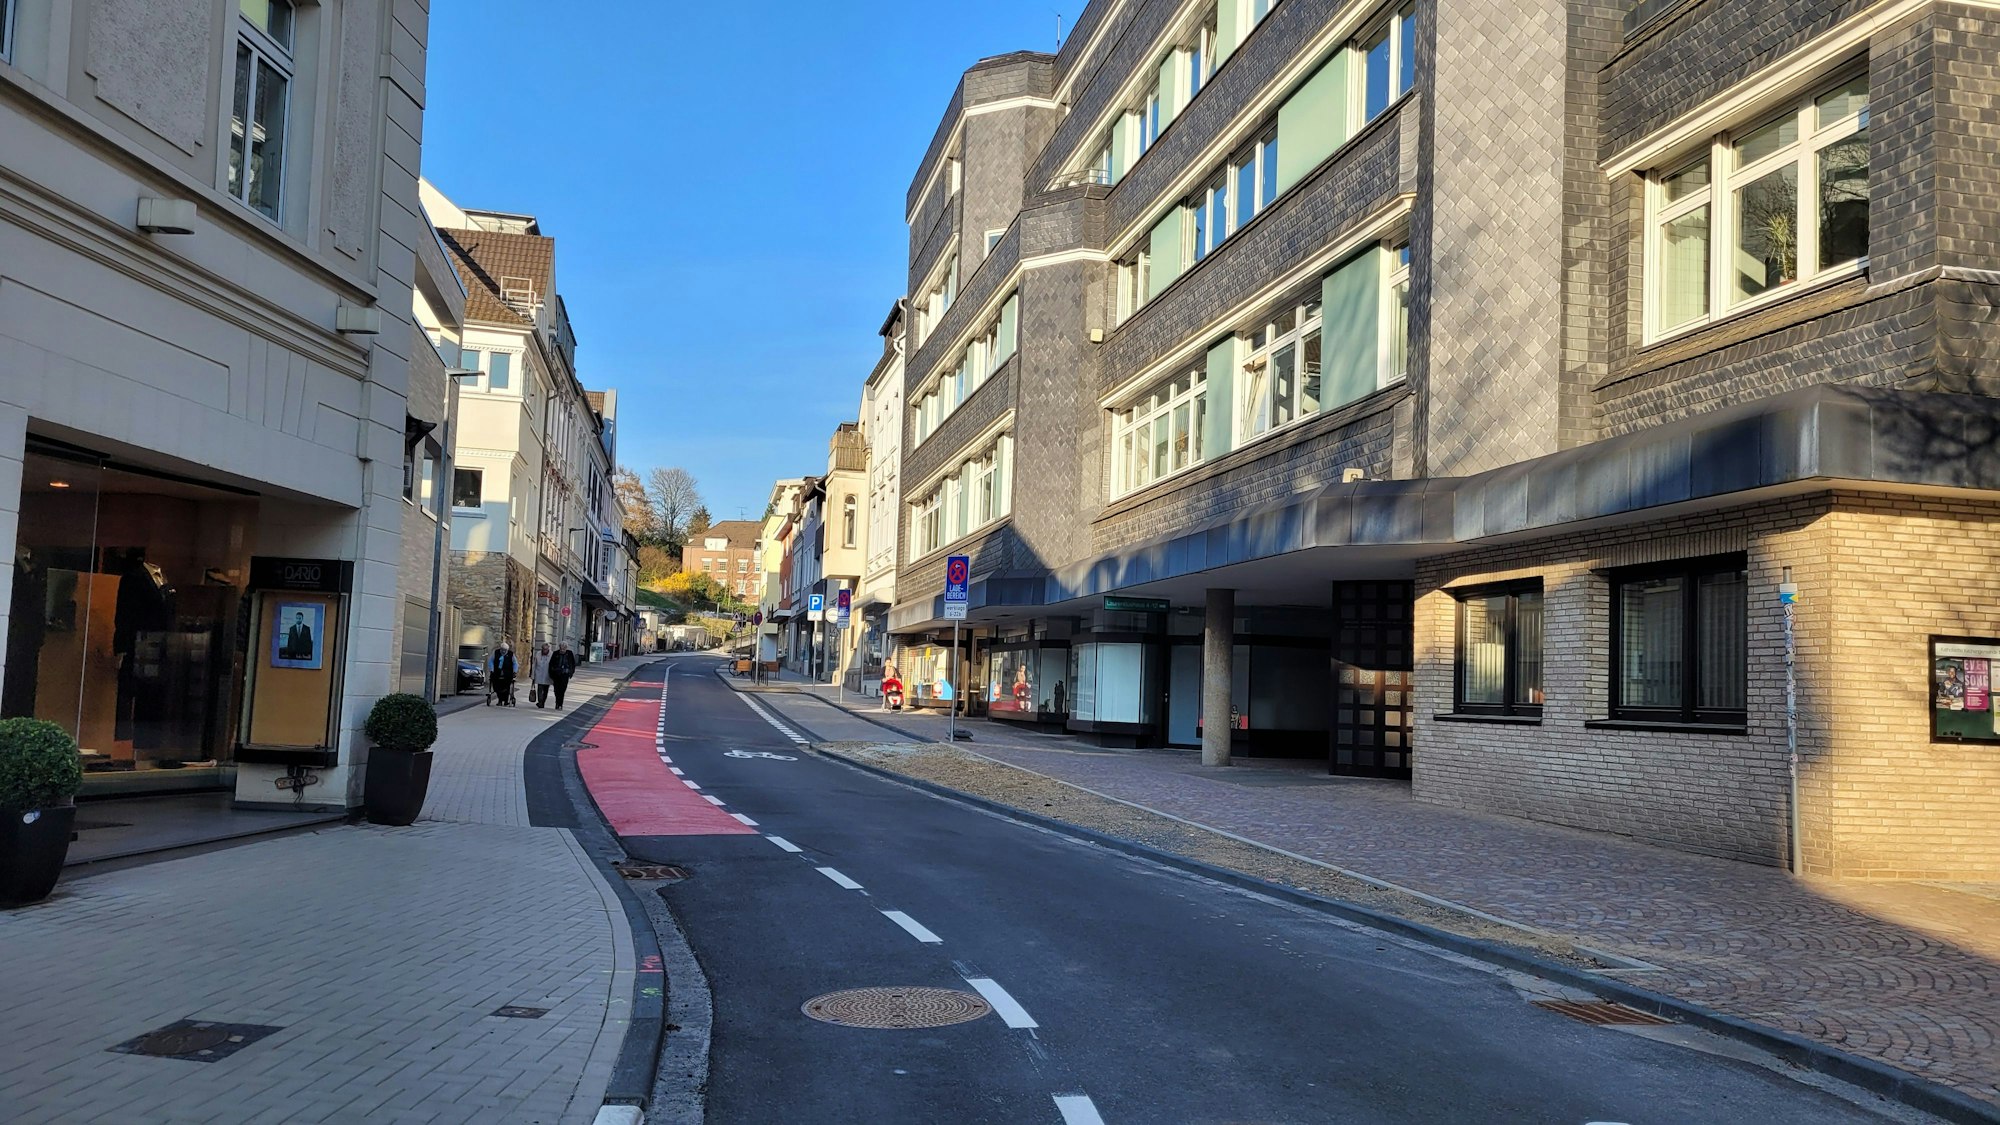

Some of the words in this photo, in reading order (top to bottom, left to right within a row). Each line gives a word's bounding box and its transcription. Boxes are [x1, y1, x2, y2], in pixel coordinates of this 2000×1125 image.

[285, 566, 320, 580] DARIO
[947, 591, 966, 599] BEREICH
[811, 597, 820, 609] P
[1965, 675, 1988, 687] SONG
